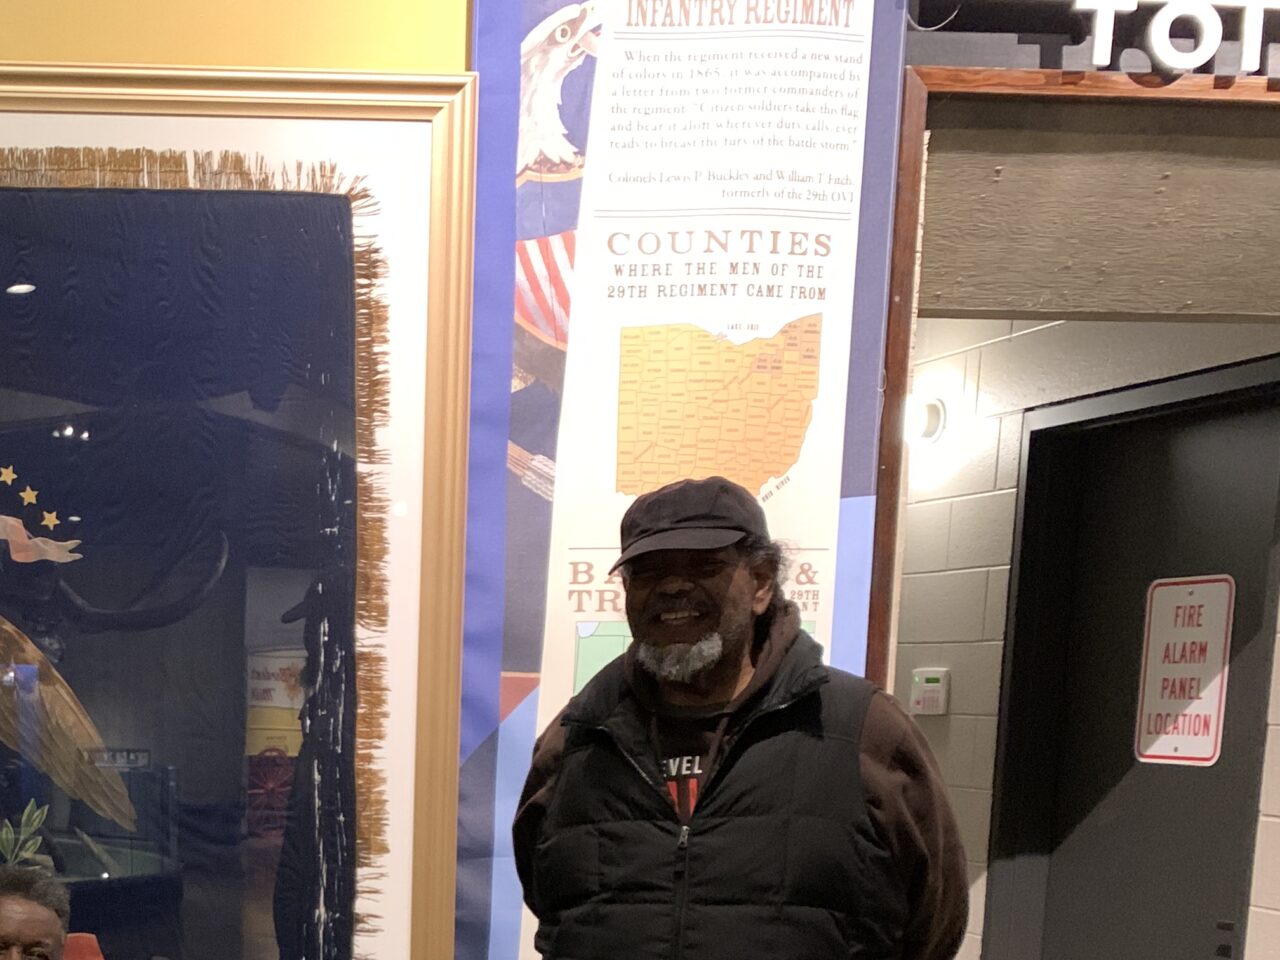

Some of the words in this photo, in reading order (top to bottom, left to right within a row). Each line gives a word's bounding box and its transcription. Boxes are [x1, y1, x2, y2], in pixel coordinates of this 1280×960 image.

[626, 0, 736, 27] INFANTRY
[744, 0, 855, 28] REGIMENT
[624, 50, 660, 62] When
[665, 50, 682, 62] the
[688, 51, 744, 65] regiment
[749, 48, 797, 60] received
[810, 52, 830, 61] new
[835, 53, 863, 65] stand
[612, 67, 624, 79] of
[628, 67, 667, 79] colors
[672, 70, 683, 79] in
[730, 69, 738, 77] it
[744, 69, 766, 77] was
[771, 68, 845, 81] accompanied
[849, 68, 861, 82] by
[622, 85, 654, 97] letter
[660, 86, 690, 97] from
[696, 88, 720, 96] two
[724, 85, 767, 96] former
[772, 85, 844, 98] commanders
[847, 87, 860, 99] of
[611, 102, 628, 114] the
[748, 99, 792, 112] soldiers
[796, 101, 816, 113] take
[820, 102, 837, 115] this
[841, 103, 860, 121] flag
[610, 119, 632, 131] and
[637, 119, 663, 131] bear
[668, 122, 676, 131] it
[682, 119, 710, 131] aloft
[716, 117, 772, 129] wherever
[776, 117, 801, 131] duty
[835, 124, 857, 134] ever
[610, 137, 640, 149] ready
[645, 140, 657, 149] to
[661, 136, 696, 149] breast
[701, 136, 718, 147] the
[724, 136, 748, 148] fury
[752, 136, 764, 147] of
[768, 133, 784, 147] the
[788, 135, 817, 149] battle
[608, 170, 656, 184] Colonels
[660, 171, 691, 183] Lewis
[708, 168, 749, 182] Buckley
[753, 168, 773, 181] and
[776, 169, 814, 183] William
[722, 187, 770, 199] formerly
[774, 186, 787, 199] of
[787, 188, 803, 200] the
[806, 189, 828, 202] 29th
[831, 190, 854, 203] OVI
[607, 230, 832, 257] COUNTIES
[614, 263, 673, 277] WHERE
[685, 262, 718, 275] THE
[729, 262, 761, 275] MEN
[771, 262, 789, 276] OF
[797, 264, 825, 279] THE
[607, 285, 648, 298] 29TH
[657, 283, 738, 297] REGIMENT
[746, 283, 784, 298] CAME
[789, 286, 827, 301] FROM
[790, 590, 820, 601] 29TH
[1174, 604, 1205, 628] FIRE
[1162, 641, 1208, 665] ALARM
[1160, 677, 1203, 701] PANEL
[1146, 712, 1211, 737] LOCATION
